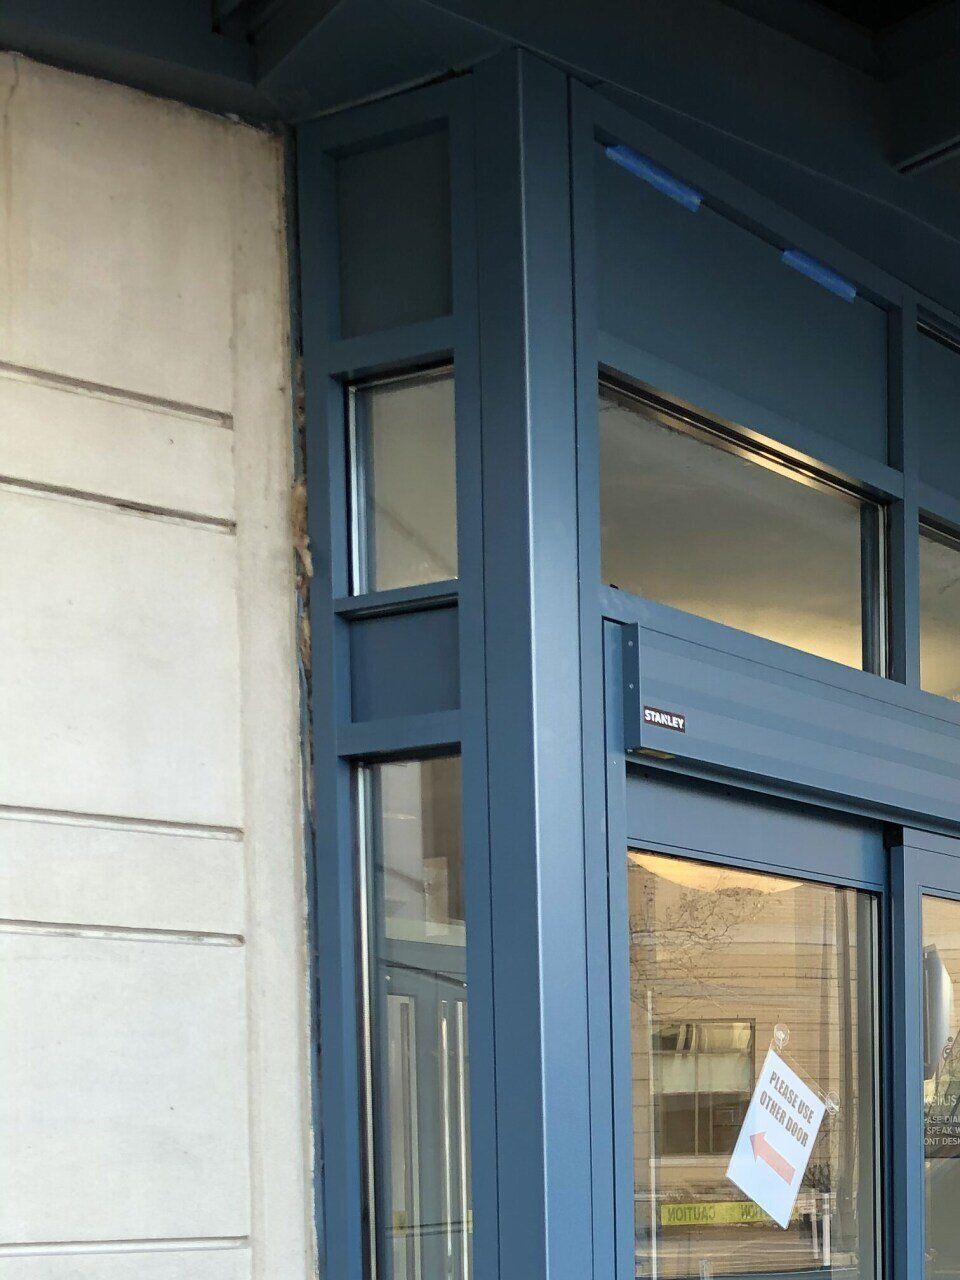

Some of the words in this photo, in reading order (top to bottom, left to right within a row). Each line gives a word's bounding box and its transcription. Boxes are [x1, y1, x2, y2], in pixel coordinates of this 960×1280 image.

[644, 708, 685, 729] STANLEY
[769, 1071, 798, 1110] PLEASE
[797, 1099, 815, 1125] USE
[759, 1090, 787, 1127] OTHER
[785, 1115, 809, 1147] DOOR
[924, 1115, 942, 1124] ASE
[926, 1126, 952, 1135] SPEAK
